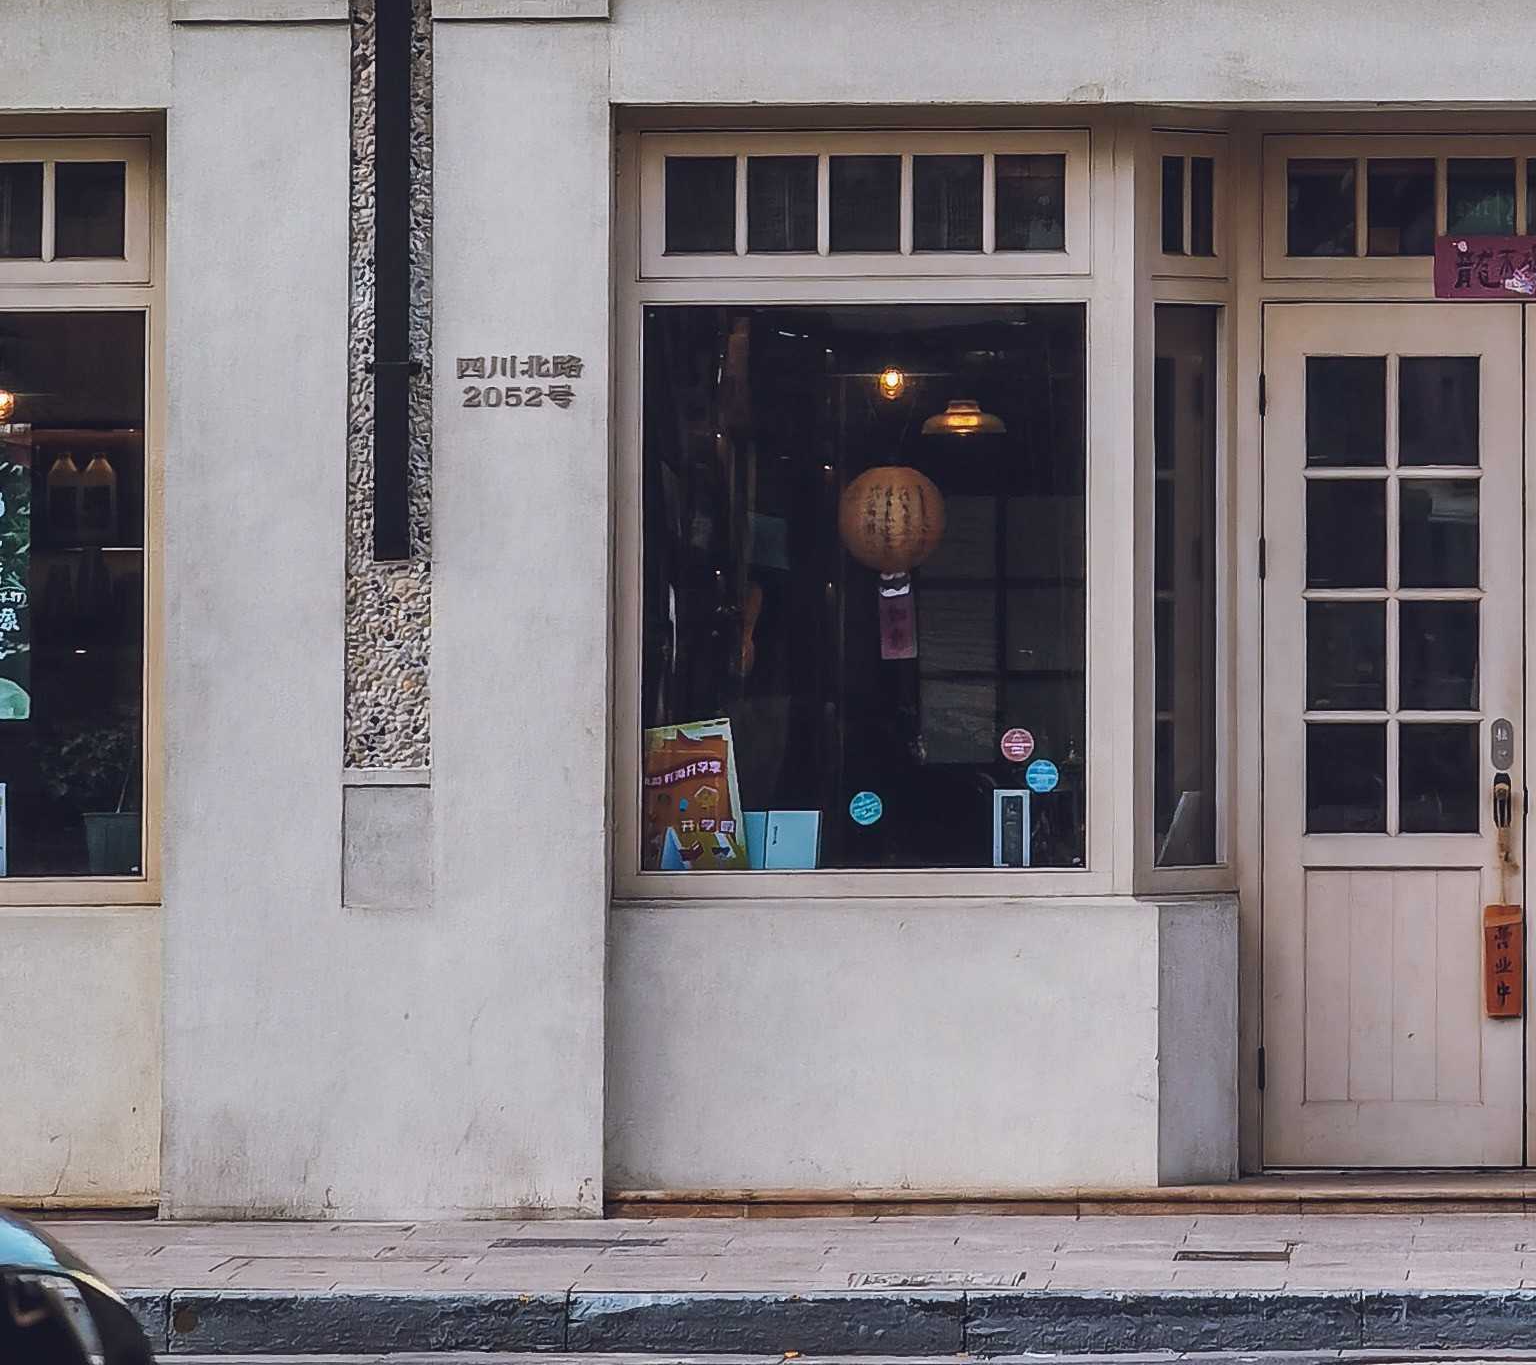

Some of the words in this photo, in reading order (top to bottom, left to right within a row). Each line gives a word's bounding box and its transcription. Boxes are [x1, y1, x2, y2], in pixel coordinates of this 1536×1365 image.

[456, 355, 584, 380] 四川北路
[462, 384, 576, 409] 2052号
